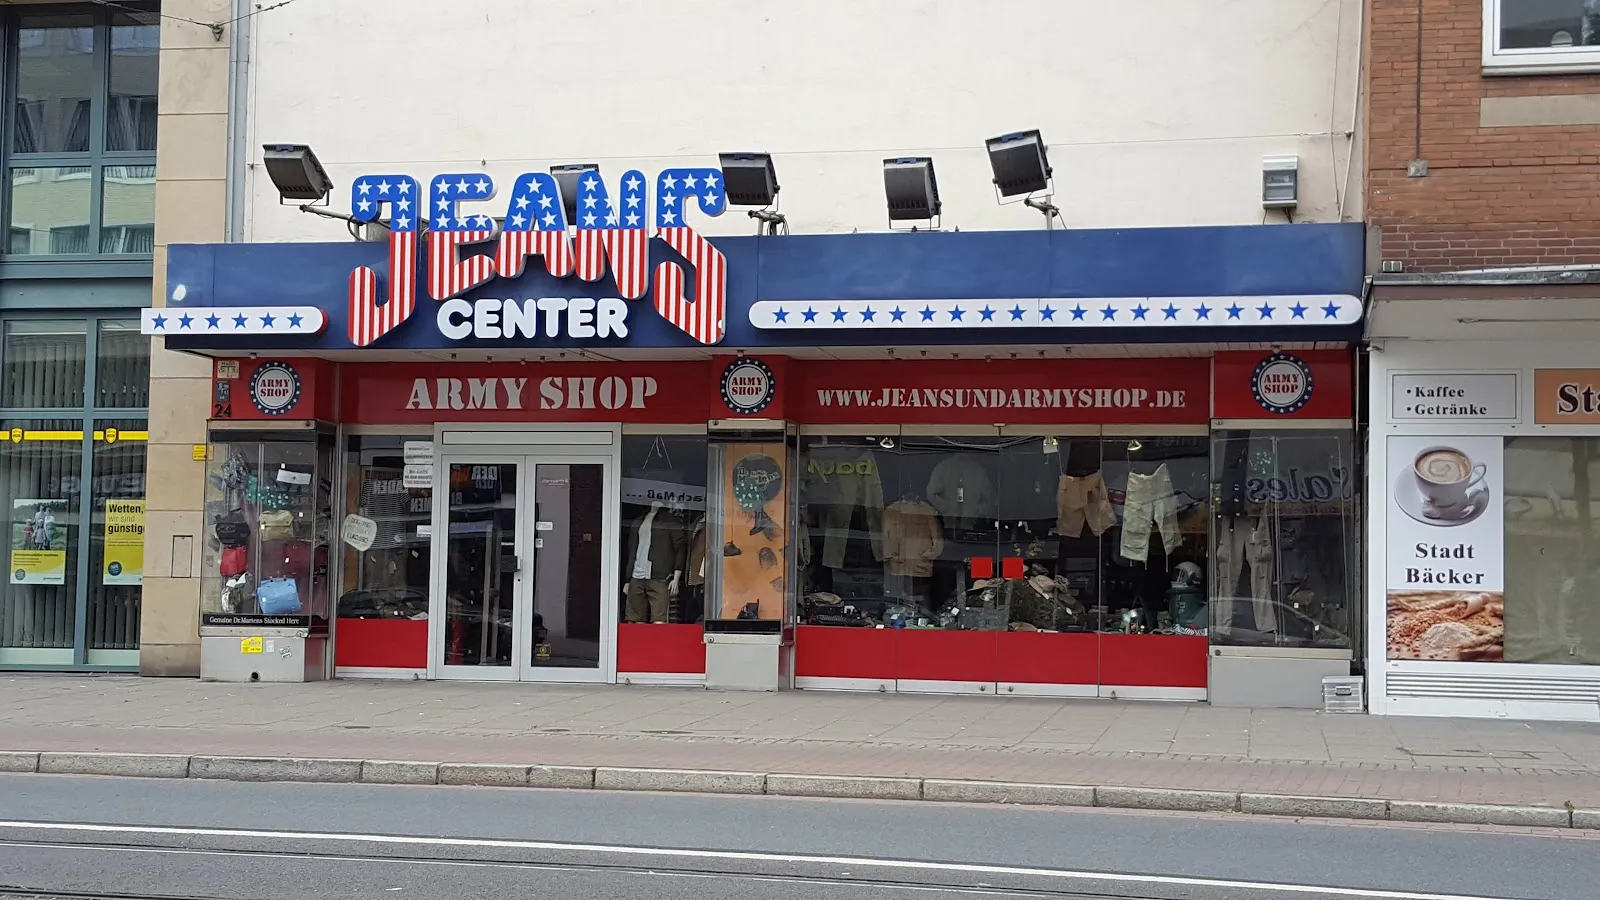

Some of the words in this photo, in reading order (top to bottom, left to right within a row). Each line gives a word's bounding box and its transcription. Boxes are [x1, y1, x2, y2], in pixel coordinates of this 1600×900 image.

[348, 168, 727, 347] JEANS
[437, 298, 629, 340] CENTER
[260, 379, 290, 388] ARMY
[731, 376, 763, 386] ARMY
[1264, 373, 1300, 384] ARMY
[260, 388, 289, 397] SHOP
[405, 377, 528, 410] ARMY
[540, 376, 658, 410] SHOP
[731, 386, 763, 396] SHOP
[1264, 383, 1299, 394] SHOP
[1414, 386, 1466, 398] Kaffee
[816, 387, 1187, 409] WWW.JEANSUNDARMYSHOP.DE
[214, 403, 233, 418] 24
[1414, 403, 1488, 415] Getränke
[109, 504, 144, 514] Wetten,
[108, 515, 119, 523] wir
[120, 515, 135, 523] sind
[108, 523, 145, 535] günstig
[1415, 542, 1475, 559] Stadt
[1405, 567, 1485, 585] Bäcker
[209, 616, 232, 624] Genuine
[264, 617, 286, 625] Stocked
[286, 617, 300, 625] Here
